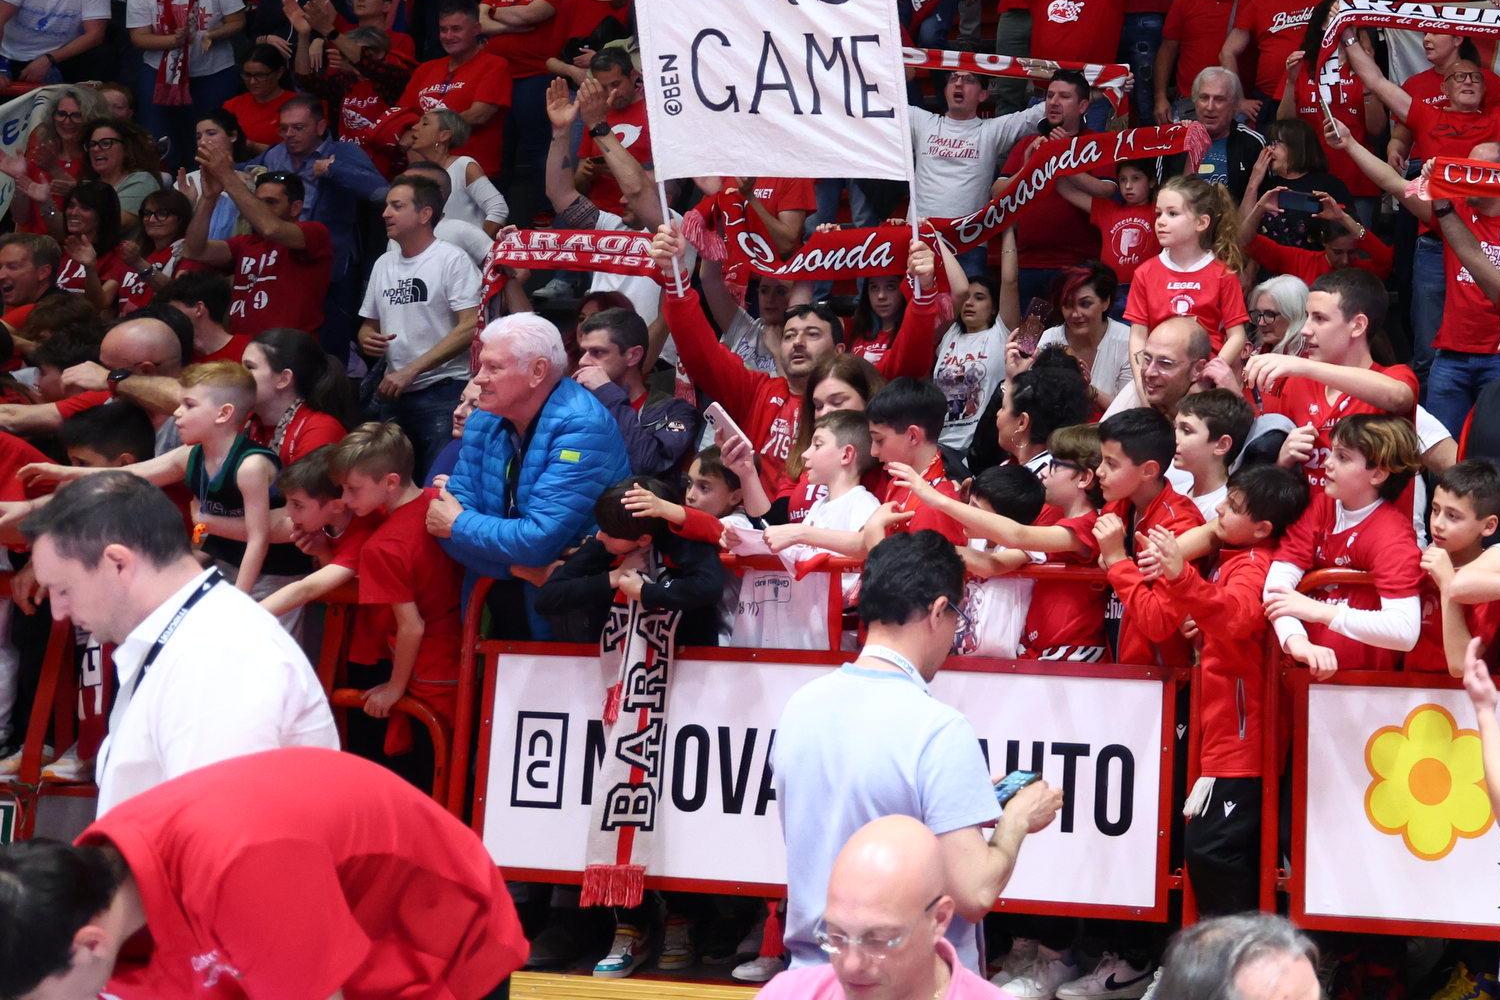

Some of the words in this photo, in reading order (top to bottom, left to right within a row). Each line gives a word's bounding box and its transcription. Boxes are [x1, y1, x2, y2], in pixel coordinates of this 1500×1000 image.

[1418, 18, 1450, 30] folle
[1455, 24, 1498, 34] amore
[691, 28, 895, 119] GAME
[955, 137, 1102, 245] Baraonda
[398, 278, 412, 288] THE
[1167, 281, 1201, 290] LEGEA
[383, 286, 411, 297] NORTH
[389, 295, 412, 305] FACE
